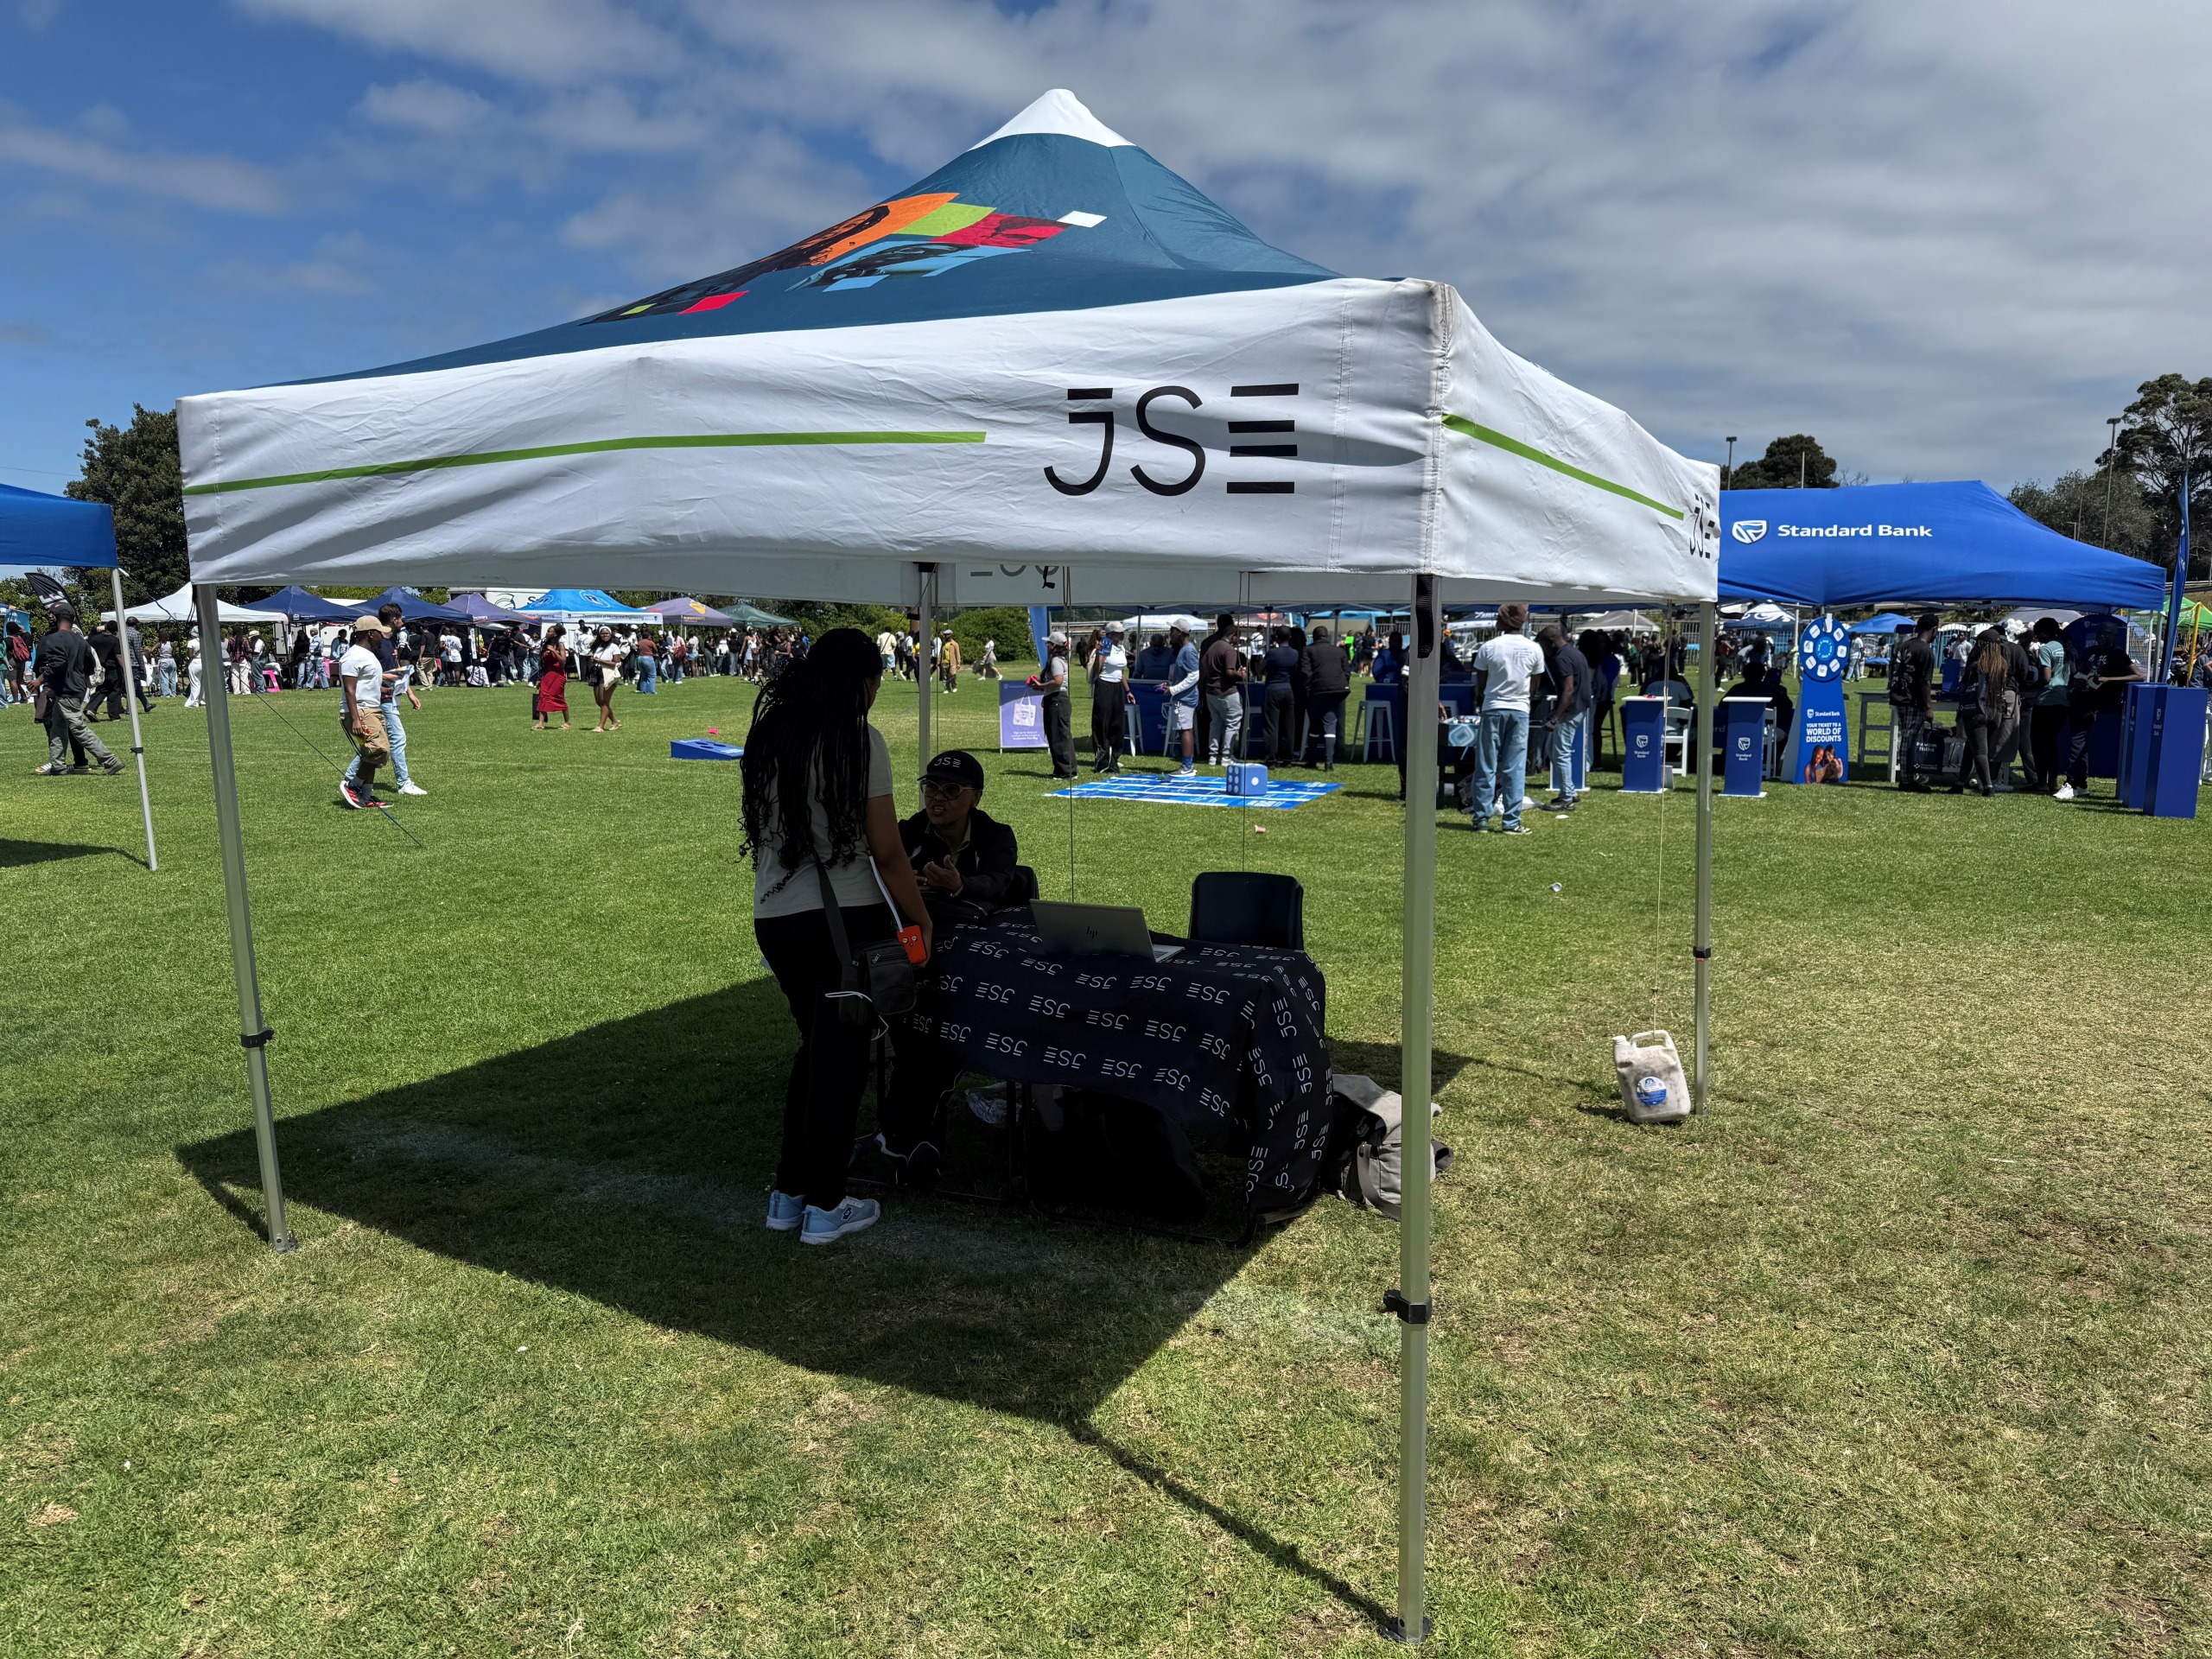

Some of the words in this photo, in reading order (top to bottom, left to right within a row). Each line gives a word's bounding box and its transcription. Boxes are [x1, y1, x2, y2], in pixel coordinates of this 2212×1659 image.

[1044, 383, 1299, 496] JSE
[1690, 493, 1715, 559] JSE
[1777, 524, 1872, 537] Standard
[1878, 524, 1933, 537] Bank
[934, 757, 962, 768] JSE
[1086, 925, 1098, 939] hp
[1200, 947, 1240, 957] JSE
[1021, 958, 1062, 975] JSE
[1076, 974, 1116, 988] JSE
[1130, 976, 1171, 991] JSE
[976, 982, 1014, 1003] JSE
[1186, 983, 1230, 1004] JSE
[1029, 995, 1070, 1018] JSE
[1086, 1010, 1128, 1029] JSE
[1273, 998, 1296, 1037] JSE
[940, 1022, 970, 1042] JSE
[1145, 1020, 1185, 1041] JSE
[985, 1033, 1027, 1056] JSE
[1199, 1033, 1230, 1059] JSE
[1044, 1046, 1086, 1069] JSE
[1101, 1059, 1141, 1077] JSE
[1249, 1046, 1272, 1086] JSE
[1154, 1069, 1190, 1091] JSE
[1293, 1053, 1312, 1093] JSE
[1199, 1088, 1230, 1116] JSE
[1294, 1110, 1309, 1151] JSE
[1312, 1123, 1329, 1160] JSE
